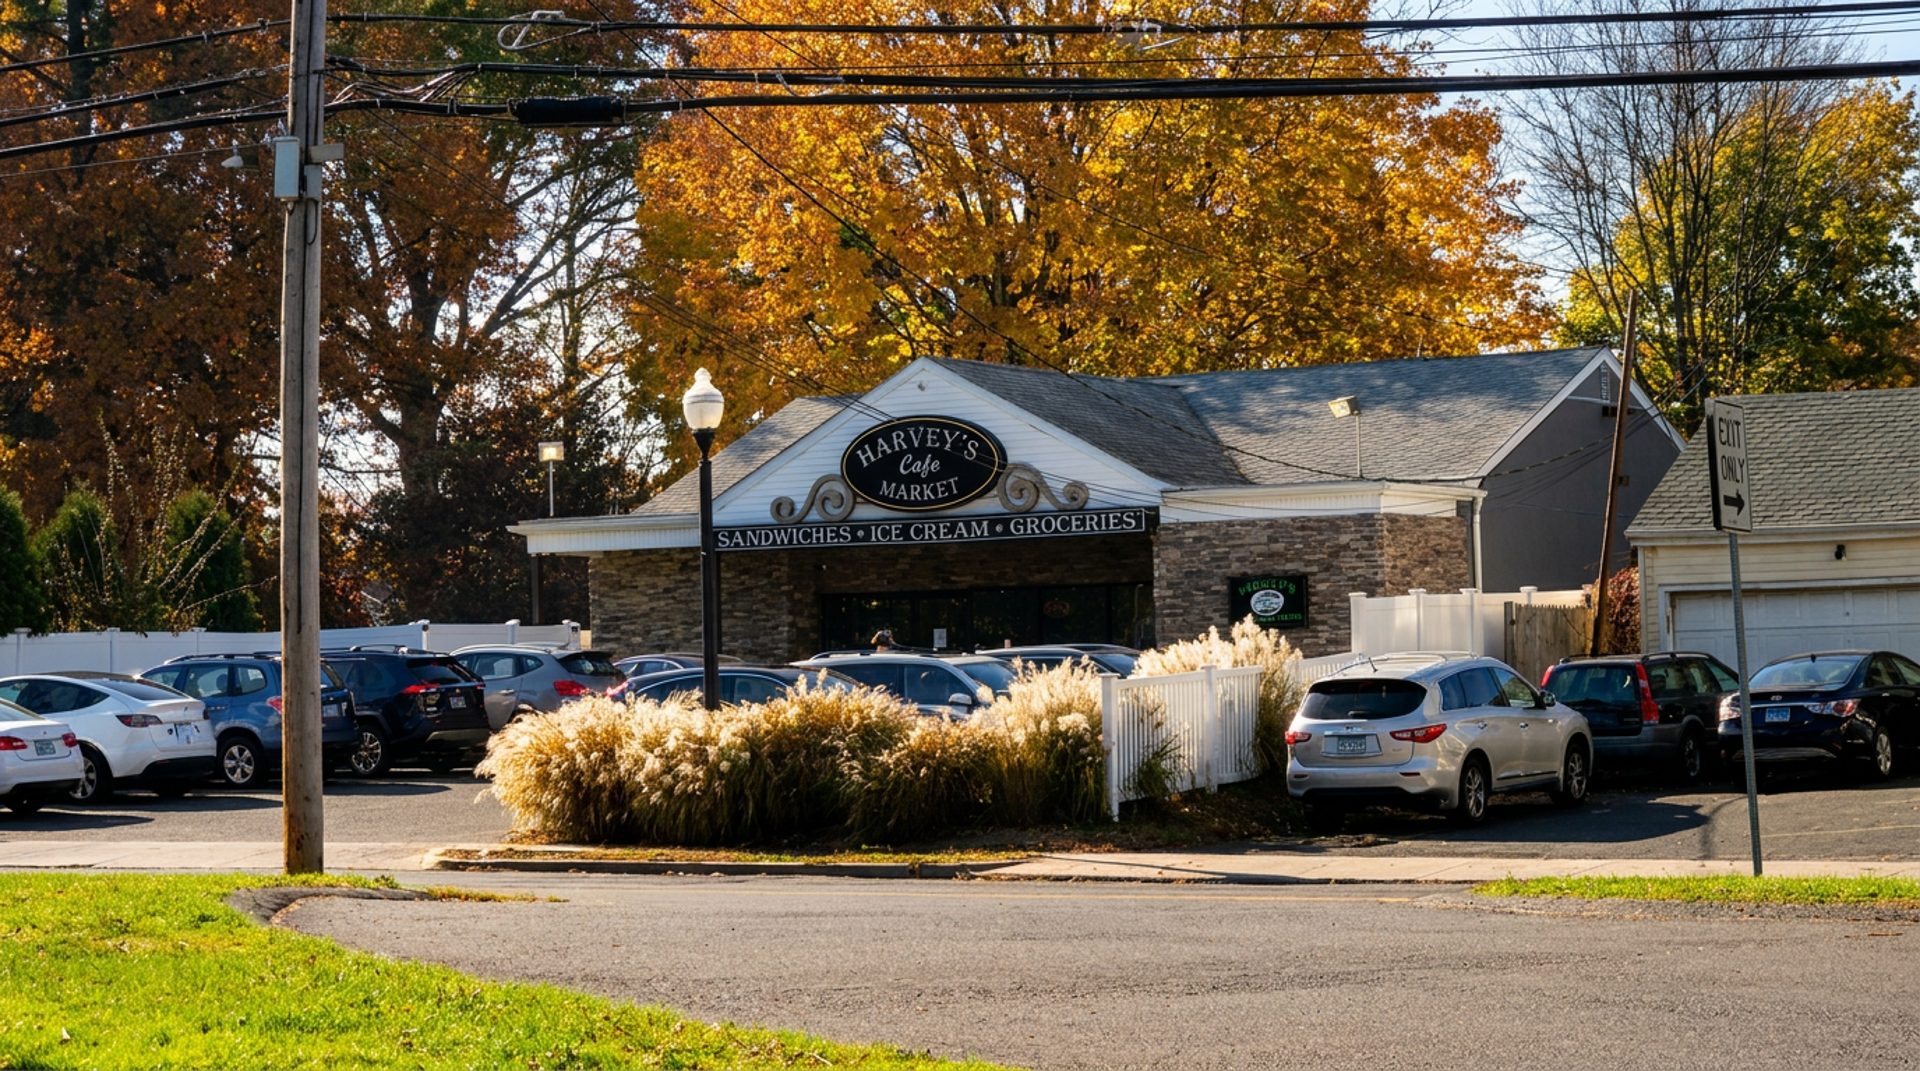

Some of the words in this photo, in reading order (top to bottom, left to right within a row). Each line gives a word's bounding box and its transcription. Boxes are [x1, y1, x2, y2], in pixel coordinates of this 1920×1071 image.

[856, 426, 979, 468] HARVEY'S
[1718, 417, 1741, 449] EXIT
[899, 453, 941, 478] Cafe
[1721, 455, 1745, 484] ONLY
[879, 477, 959, 500] MARKET
[717, 526, 851, 547] SANDWICHES
[870, 524, 903, 542] ICE
[910, 520, 990, 540] CREAM
